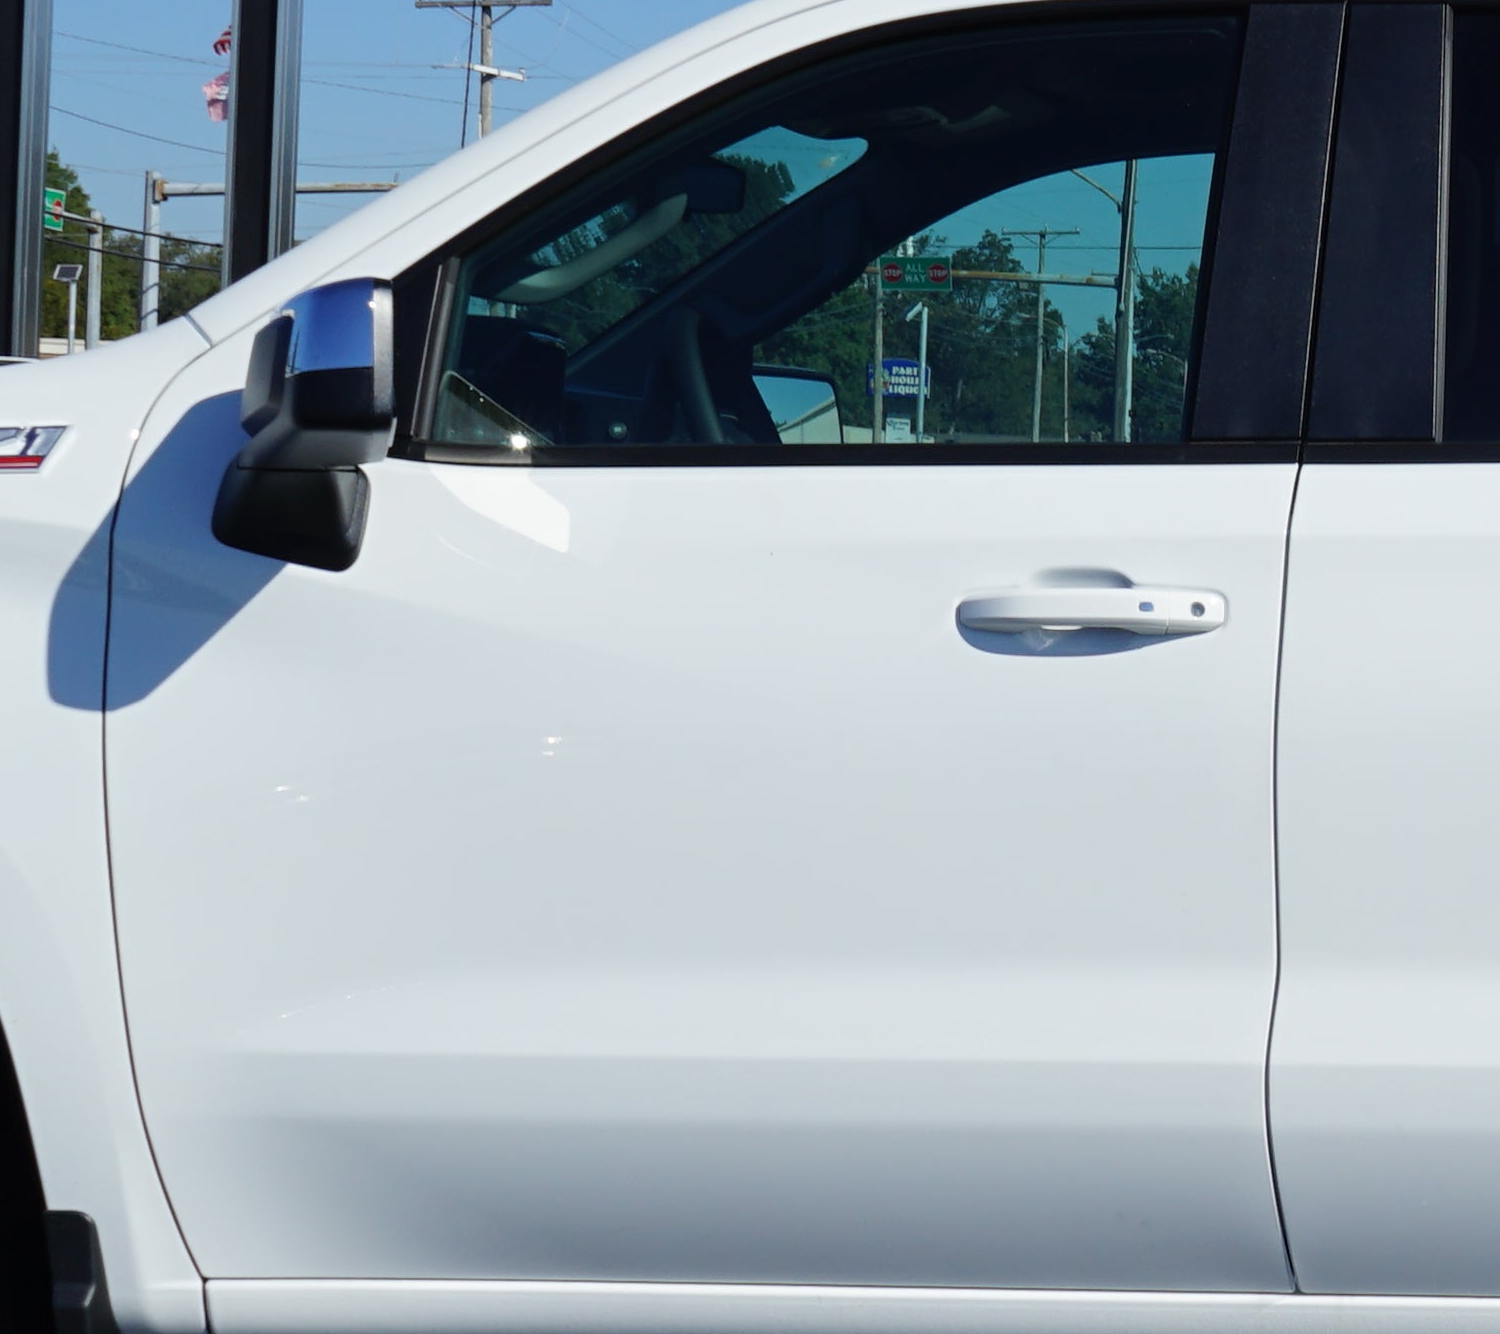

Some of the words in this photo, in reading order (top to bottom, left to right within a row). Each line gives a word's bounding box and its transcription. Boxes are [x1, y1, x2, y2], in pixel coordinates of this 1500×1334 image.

[905, 263, 925, 273] ALL
[883, 269, 902, 277] STOP
[928, 269, 949, 278] STOP
[905, 274, 927, 283] WAY
